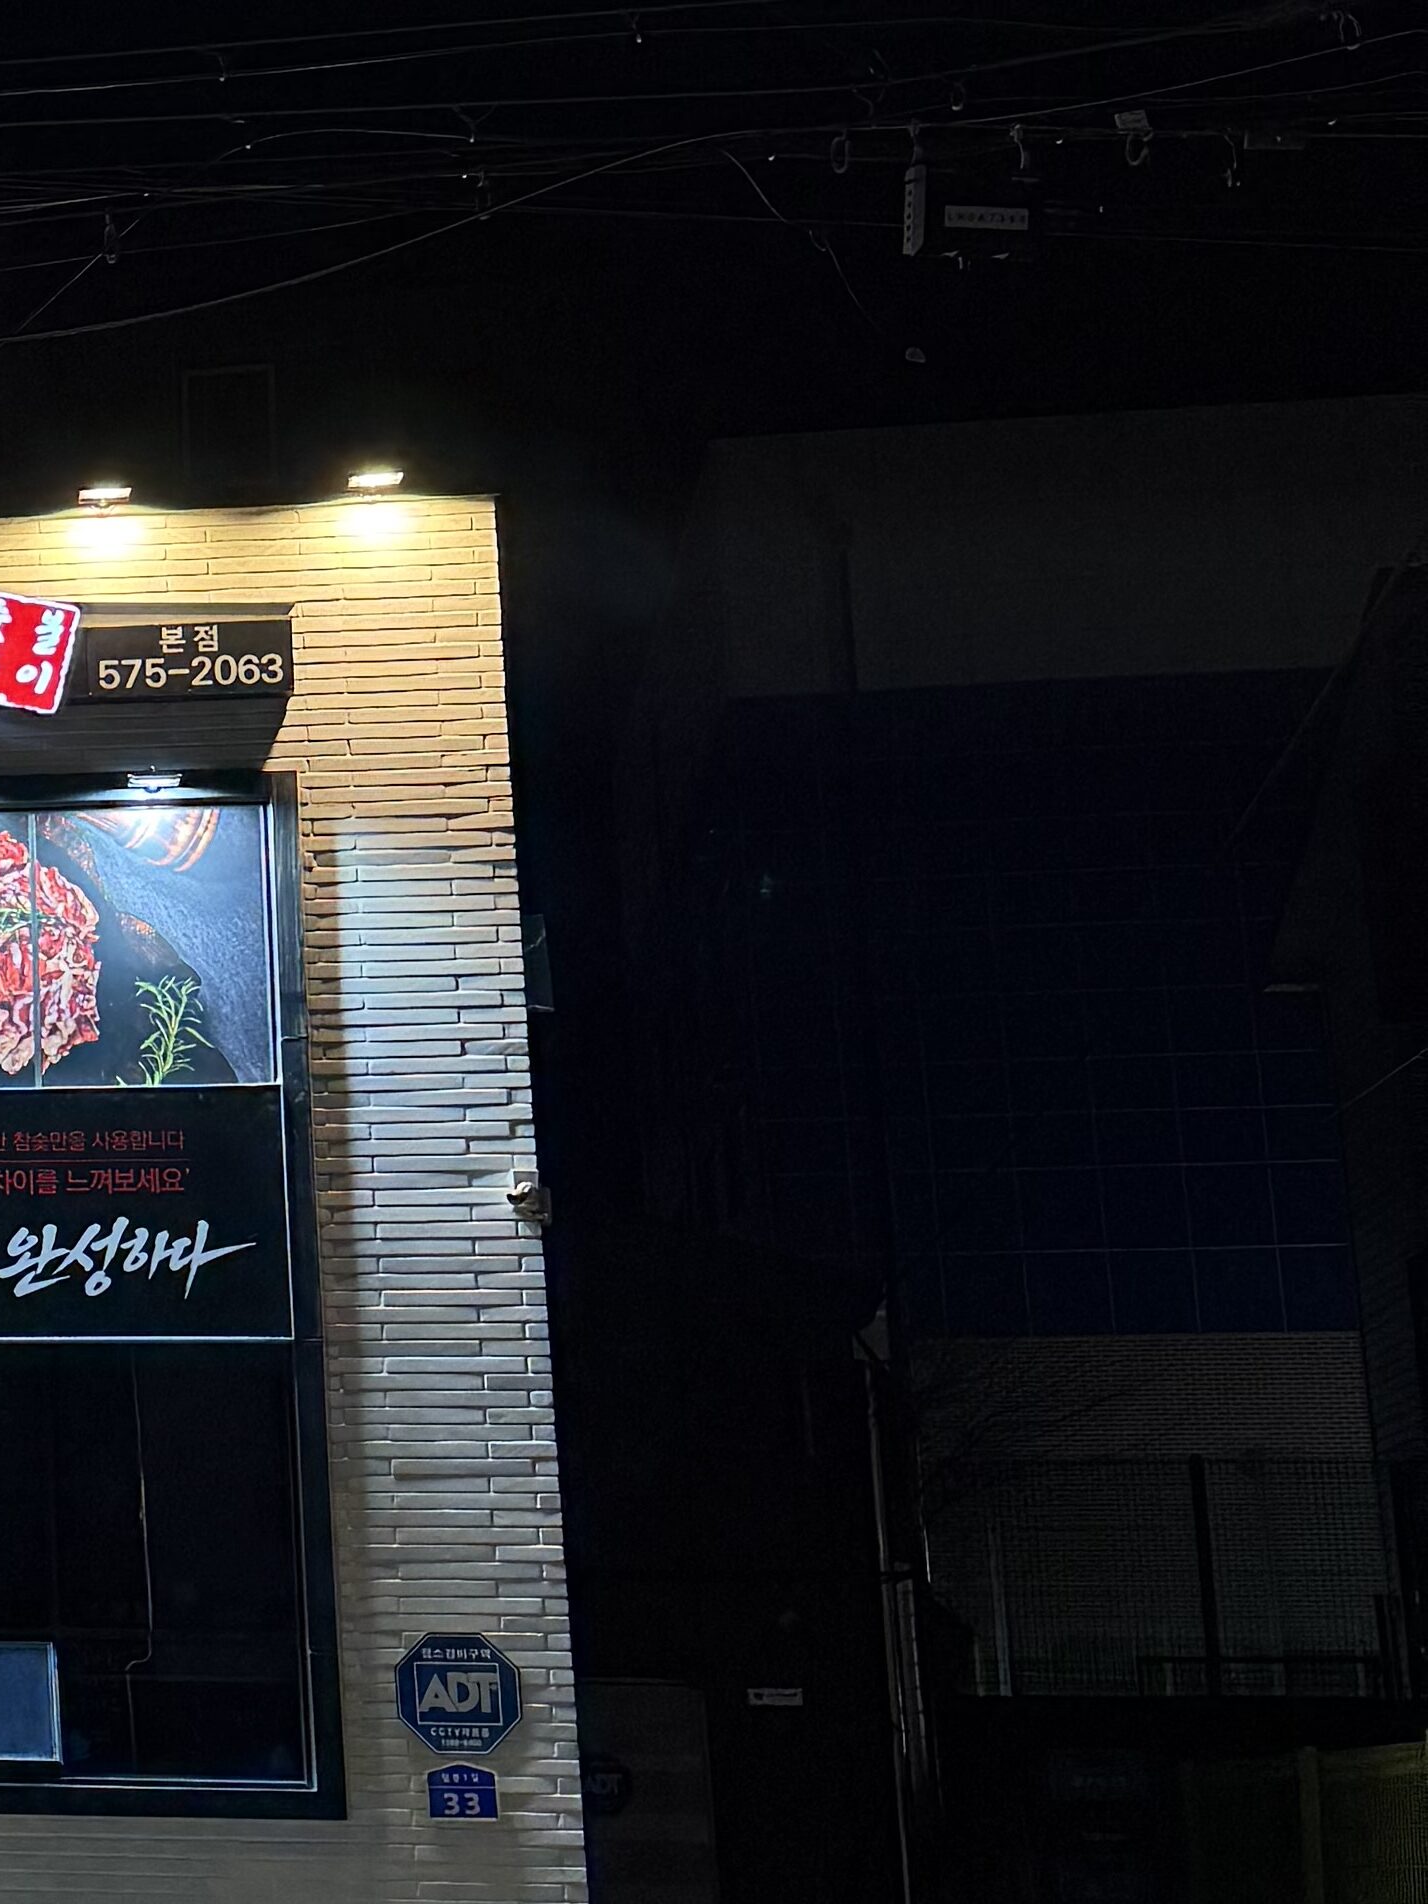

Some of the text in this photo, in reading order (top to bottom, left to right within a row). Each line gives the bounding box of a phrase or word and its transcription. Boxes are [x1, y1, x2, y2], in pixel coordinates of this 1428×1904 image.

[158, 624, 219, 654] 본점
[99, 652, 284, 691] 575-2063
[13, 1130, 87, 1153] 참숯만을
[92, 1130, 185, 1152] 사용합니다
[419, 1670, 497, 1714] ADT
[443, 1792, 481, 1816] 33
